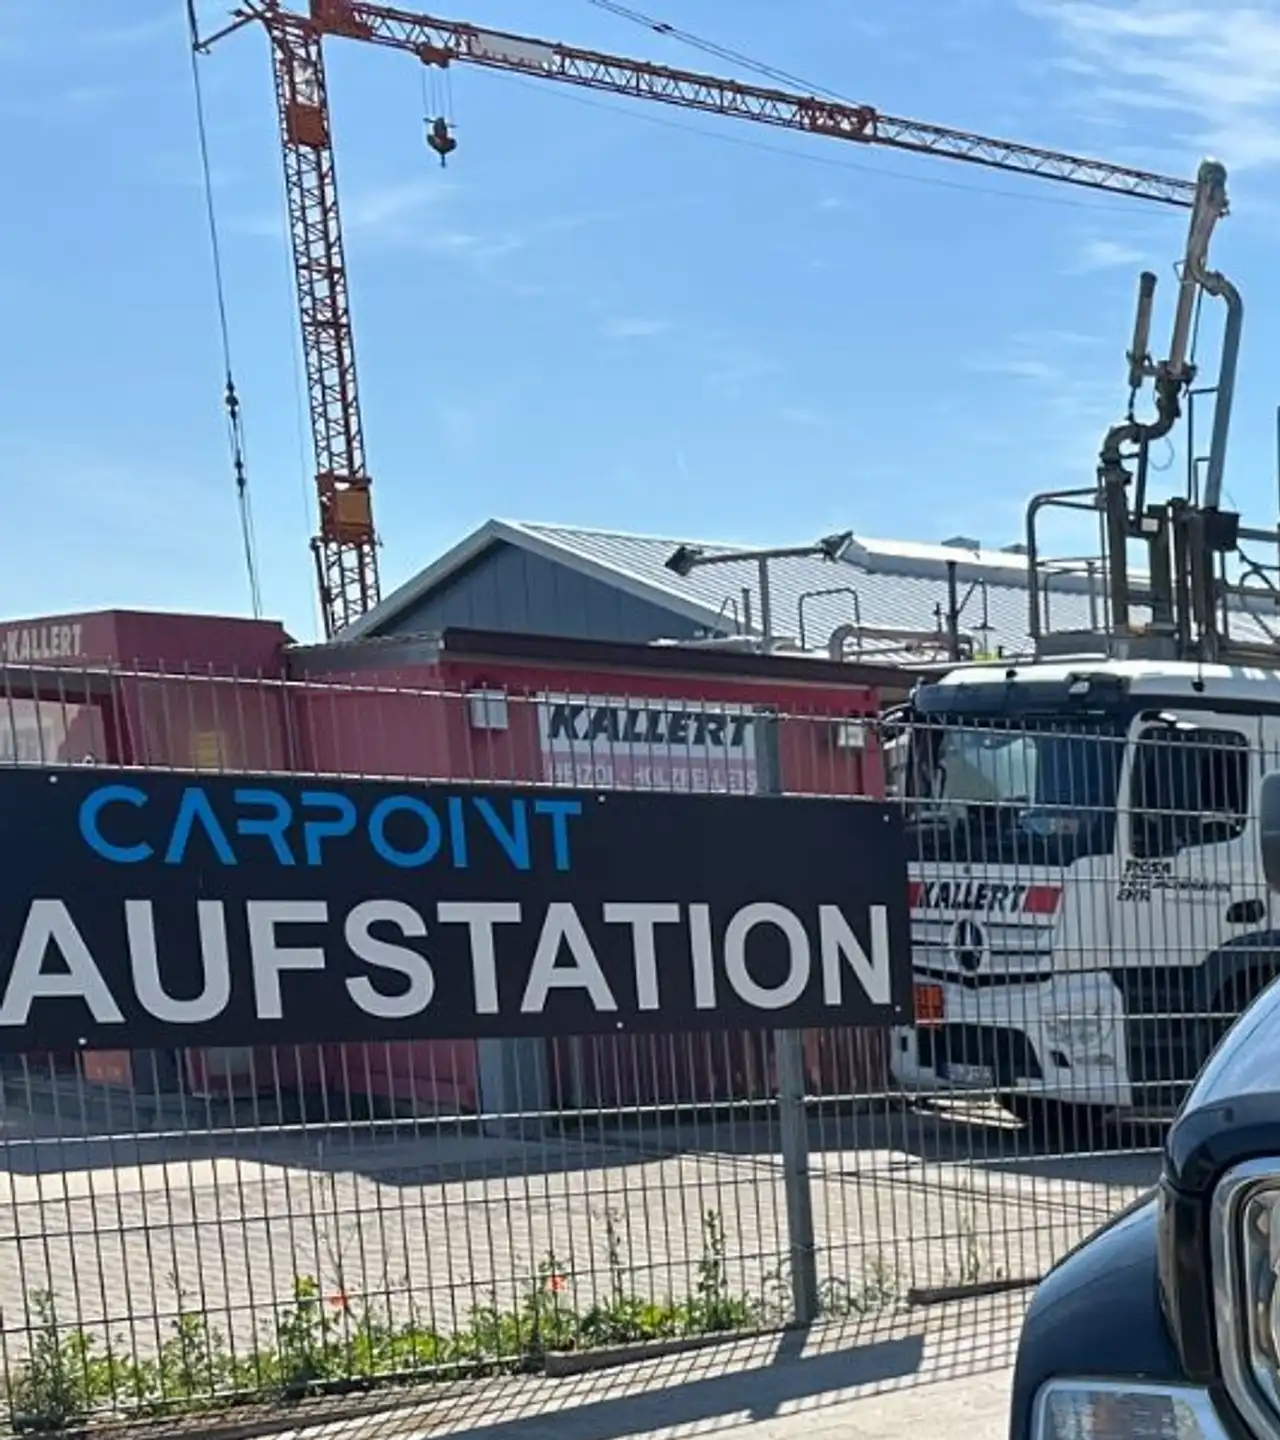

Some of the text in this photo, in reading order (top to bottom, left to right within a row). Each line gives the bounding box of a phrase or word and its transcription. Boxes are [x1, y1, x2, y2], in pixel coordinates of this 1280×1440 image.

[7, 624, 82, 662] KALLERT
[548, 702, 754, 747] KALLERT
[79, 784, 582, 871] CARPOINT
[918, 880, 1027, 913] KALLERT
[0, 898, 892, 1026] AUFSTATION
